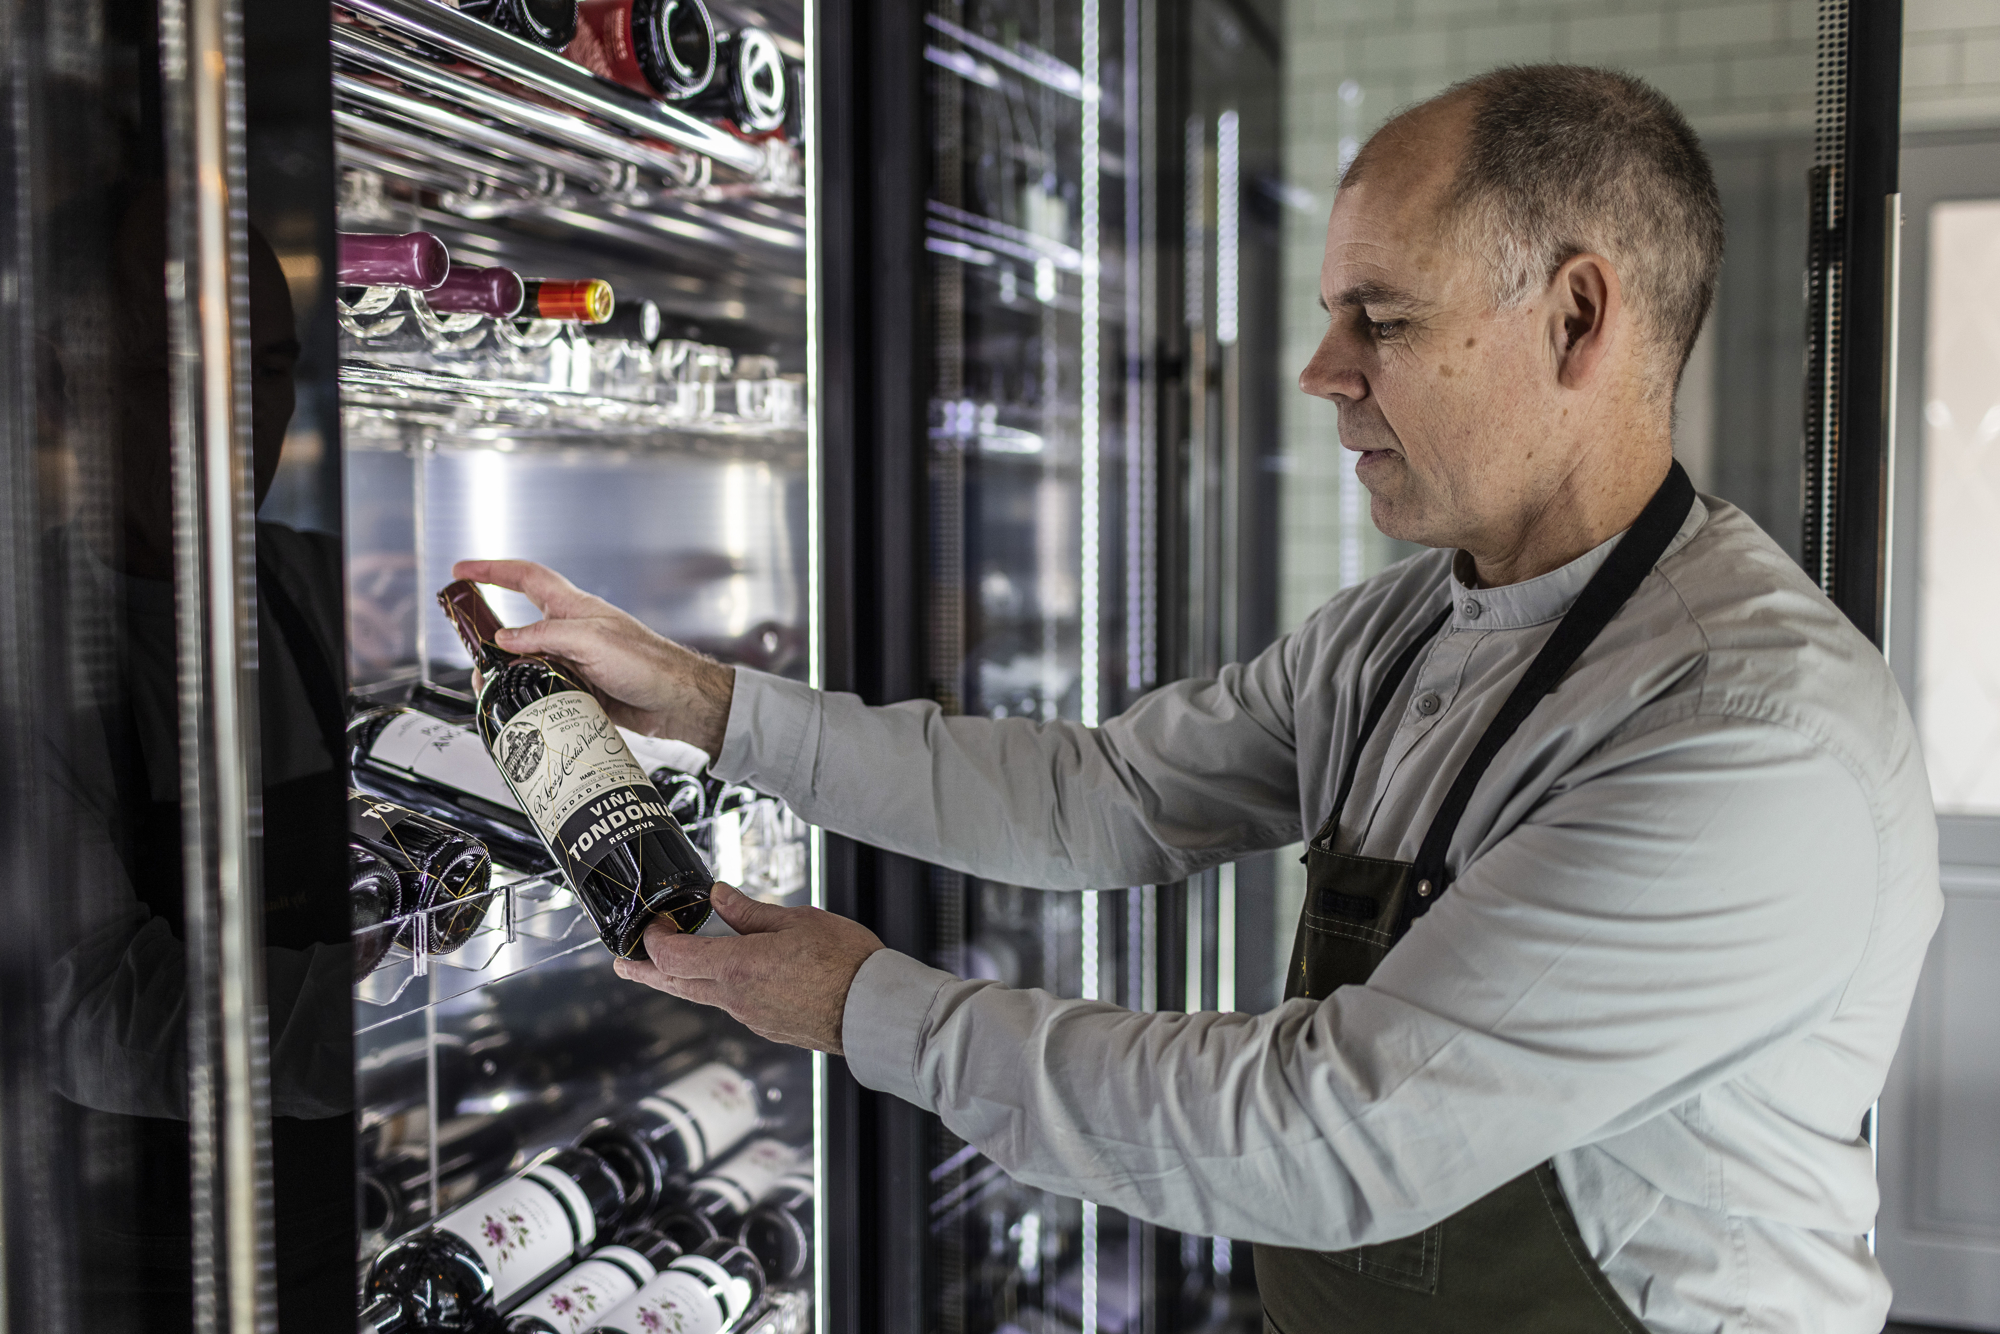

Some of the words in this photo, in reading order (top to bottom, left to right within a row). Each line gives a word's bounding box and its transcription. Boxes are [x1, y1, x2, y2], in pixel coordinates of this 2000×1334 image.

[548, 707, 580, 722] RIOJA
[559, 721, 580, 733] 2010
[579, 770, 596, 781] HARO
[551, 783, 602, 827] FUNDADA
[610, 775, 625, 783] EN
[589, 792, 638, 817] VIÑA
[568, 802, 672, 861] TONDONIA
[608, 821, 655, 845] RESERVA
